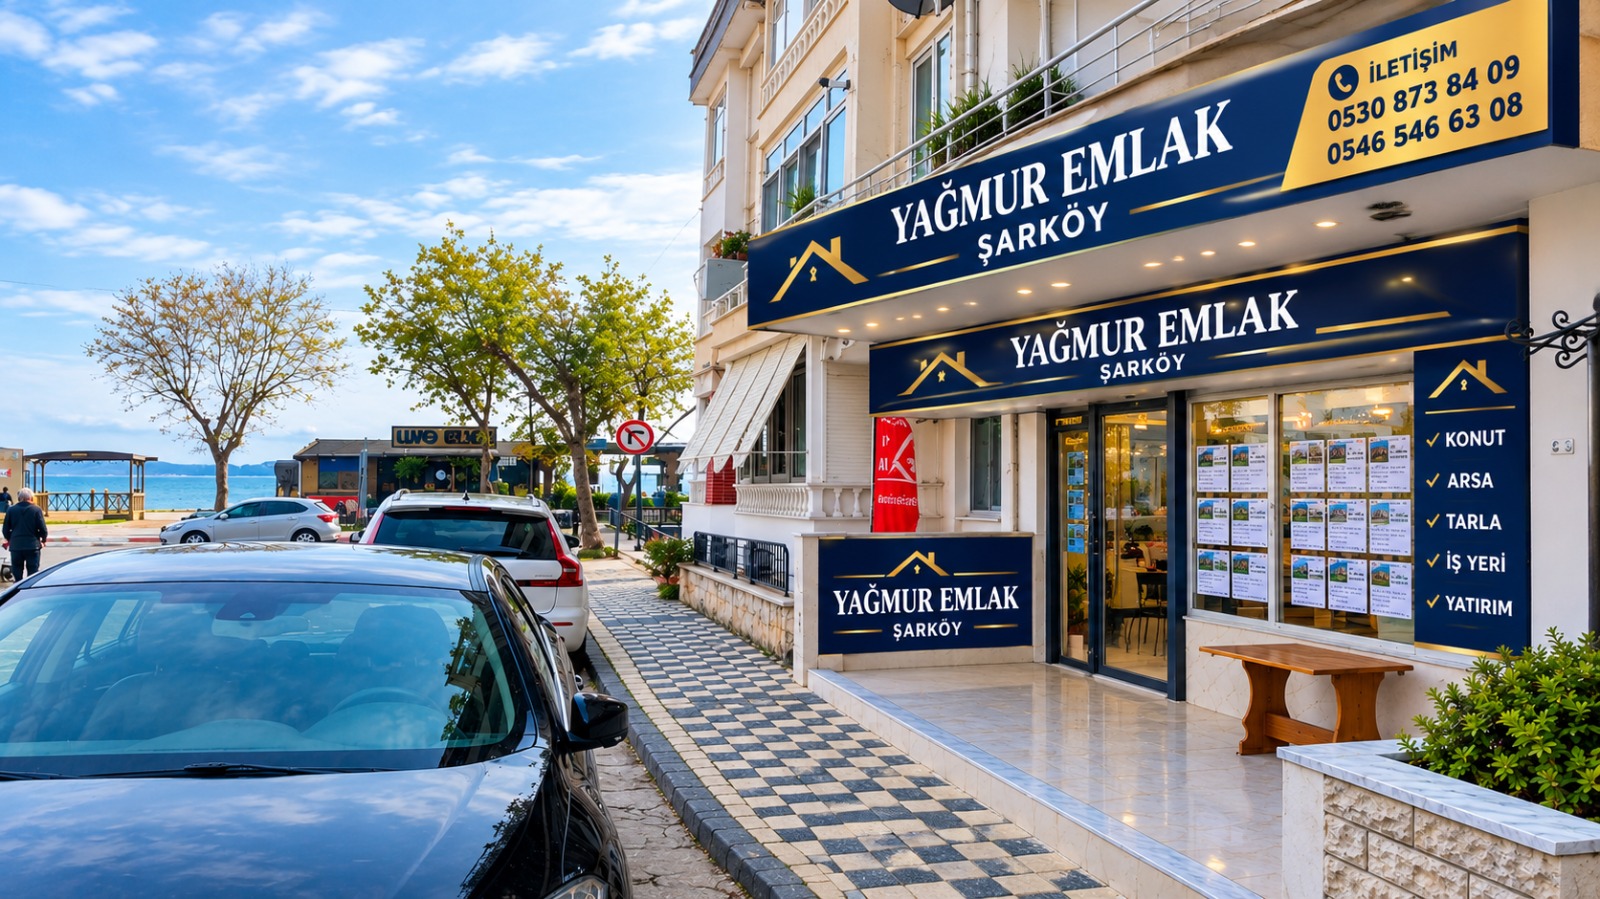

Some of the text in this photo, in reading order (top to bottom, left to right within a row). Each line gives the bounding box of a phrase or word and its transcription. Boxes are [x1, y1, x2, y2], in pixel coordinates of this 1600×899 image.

[1369, 41, 1457, 83] İLETİŞİM
[1328, 55, 1520, 132] 0530 873 84 09
[1328, 92, 1523, 165] 0546 546 63 08
[890, 98, 1235, 246] YAĞMUR EMLAK
[977, 201, 1110, 268] ŞARKÖY
[1010, 289, 1299, 369] YAĞMUR EMLAK
[1100, 353, 1187, 385] ŞARKÖY
[1445, 429, 1506, 448] KONUT
[1447, 472, 1494, 489] ARSA
[1445, 513, 1502, 531] TARLA
[1446, 550, 1506, 575] İŞ YERİ
[832, 583, 1020, 616] YAĞMUR EMLAK
[1445, 595, 1513, 617] YATIRIM
[893, 618, 963, 642] ŞARKÖY
